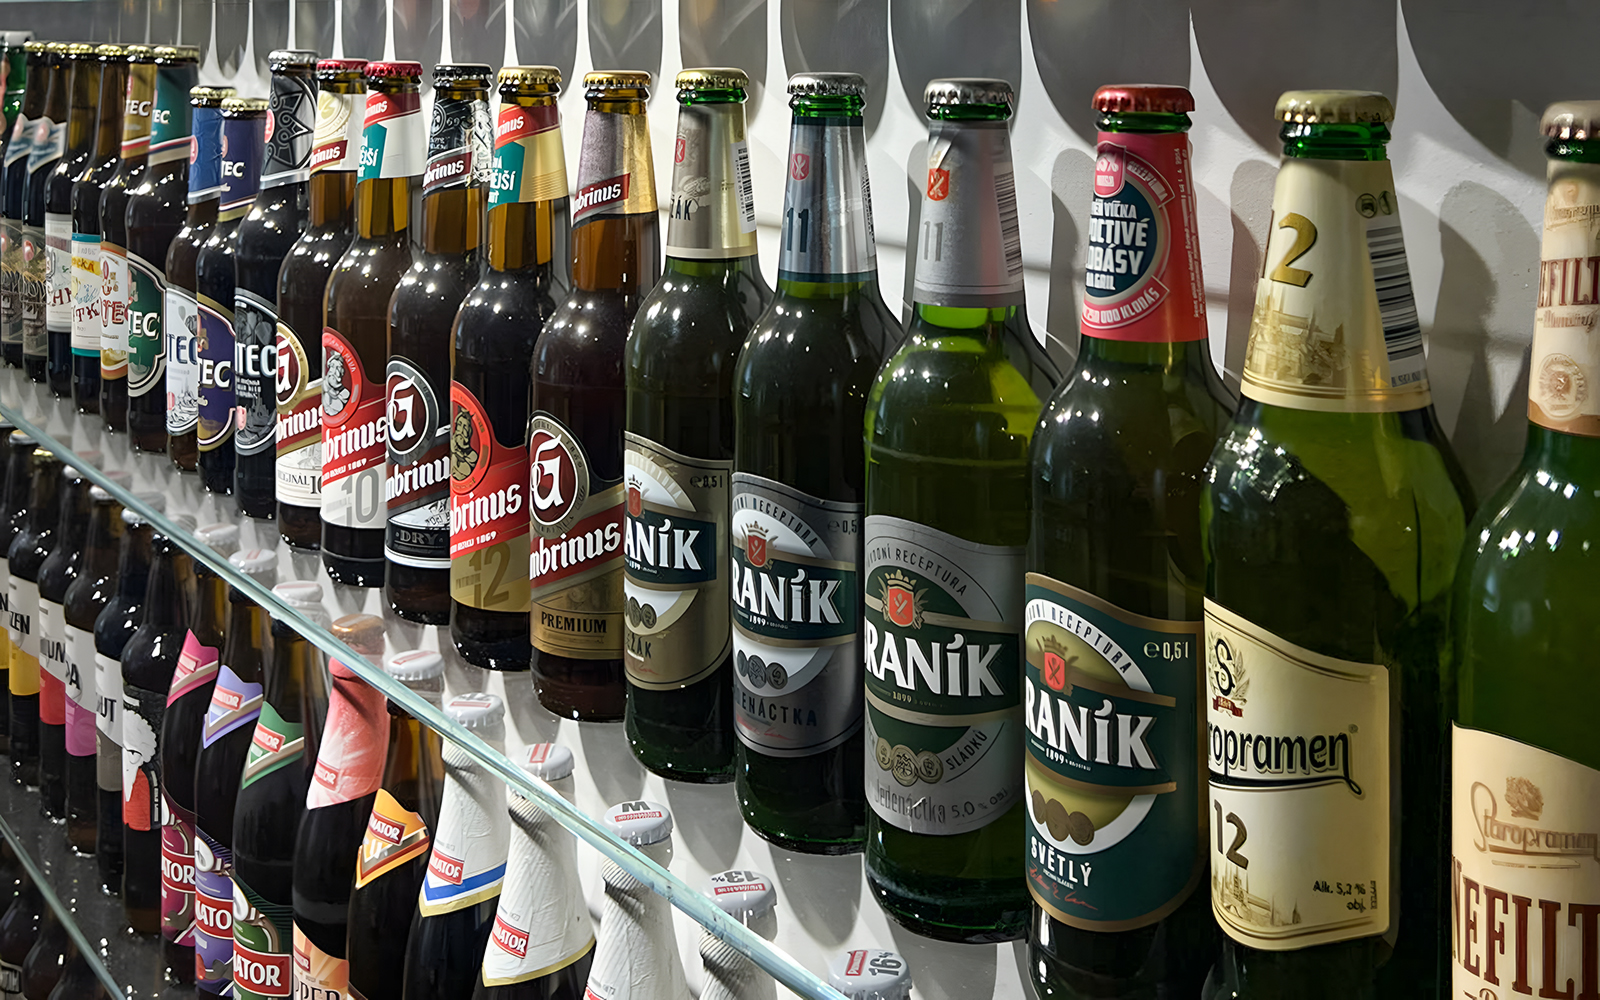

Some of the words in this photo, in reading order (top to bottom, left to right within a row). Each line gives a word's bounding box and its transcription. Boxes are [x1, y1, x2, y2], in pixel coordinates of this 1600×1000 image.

[787, 207, 809, 253] 11
[924, 220, 944, 262] 11
[341, 467, 379, 527] 10
[400, 529, 438, 545] DRY
[468, 542, 511, 609] 12
[895, 547, 968, 596] RECEPTURA
[541, 611, 607, 634] PREMIUM
[1051, 606, 1132, 674] RECEPTURA
[865, 616, 1005, 697] RANÍK
[1026, 675, 1157, 770] RANÍK
[945, 730, 988, 771] SLÁDKŮ
[875, 779, 946, 824] Jedenáctka
[1213, 799, 1249, 871] 12
[1031, 835, 1092, 887] SVĚTLÝ
[1313, 880, 1333, 894] Alk.
[1336, 882, 1352, 896] 5,2
